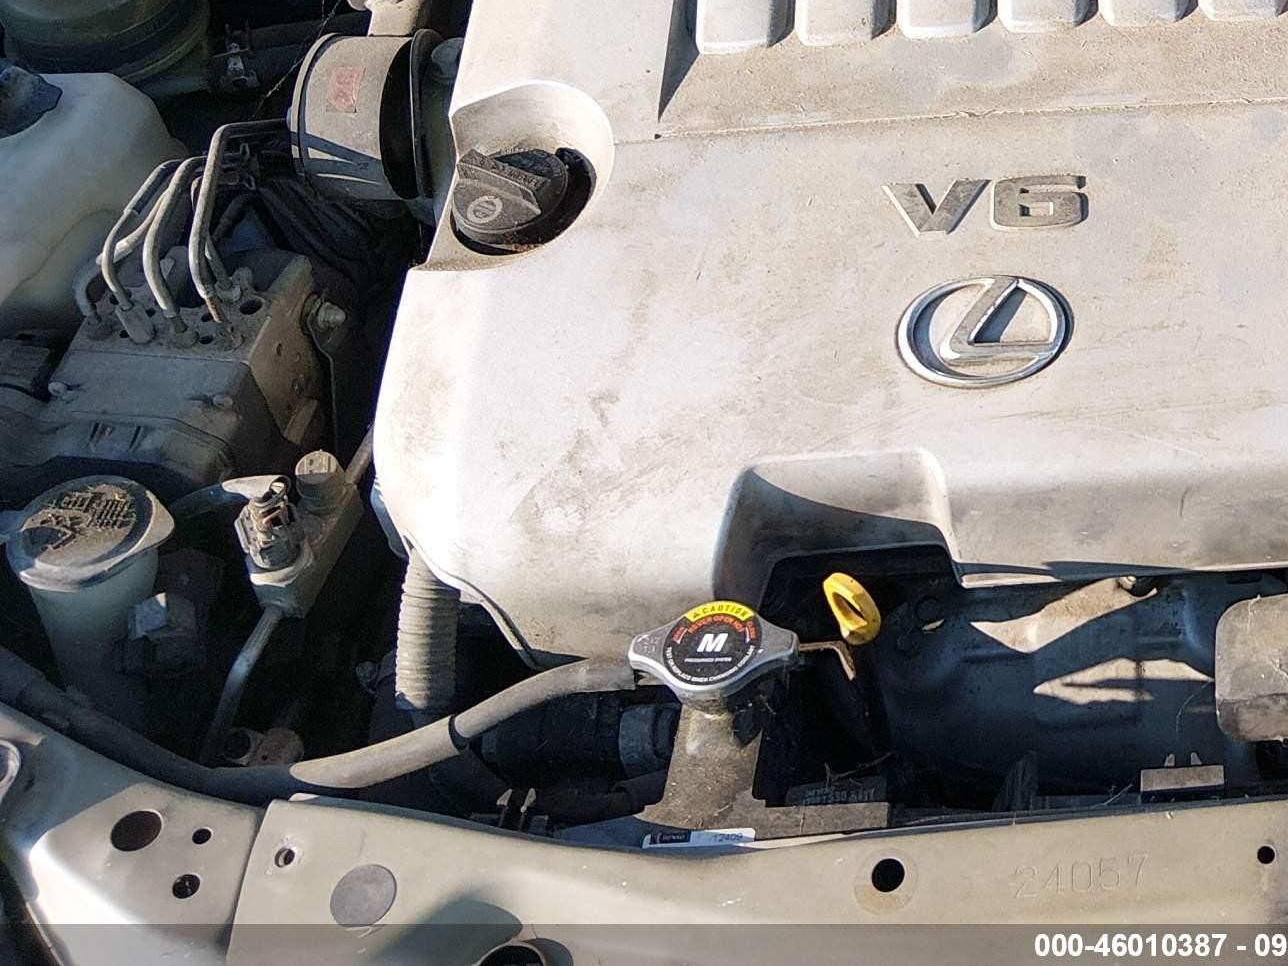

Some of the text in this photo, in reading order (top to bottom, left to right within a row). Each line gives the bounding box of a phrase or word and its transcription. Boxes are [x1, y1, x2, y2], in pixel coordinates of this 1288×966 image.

[881, 174, 1090, 237] V6
[702, 605, 748, 619] CAUTION
[697, 633, 729, 652] M
[1014, 853, 1149, 898] 24057
